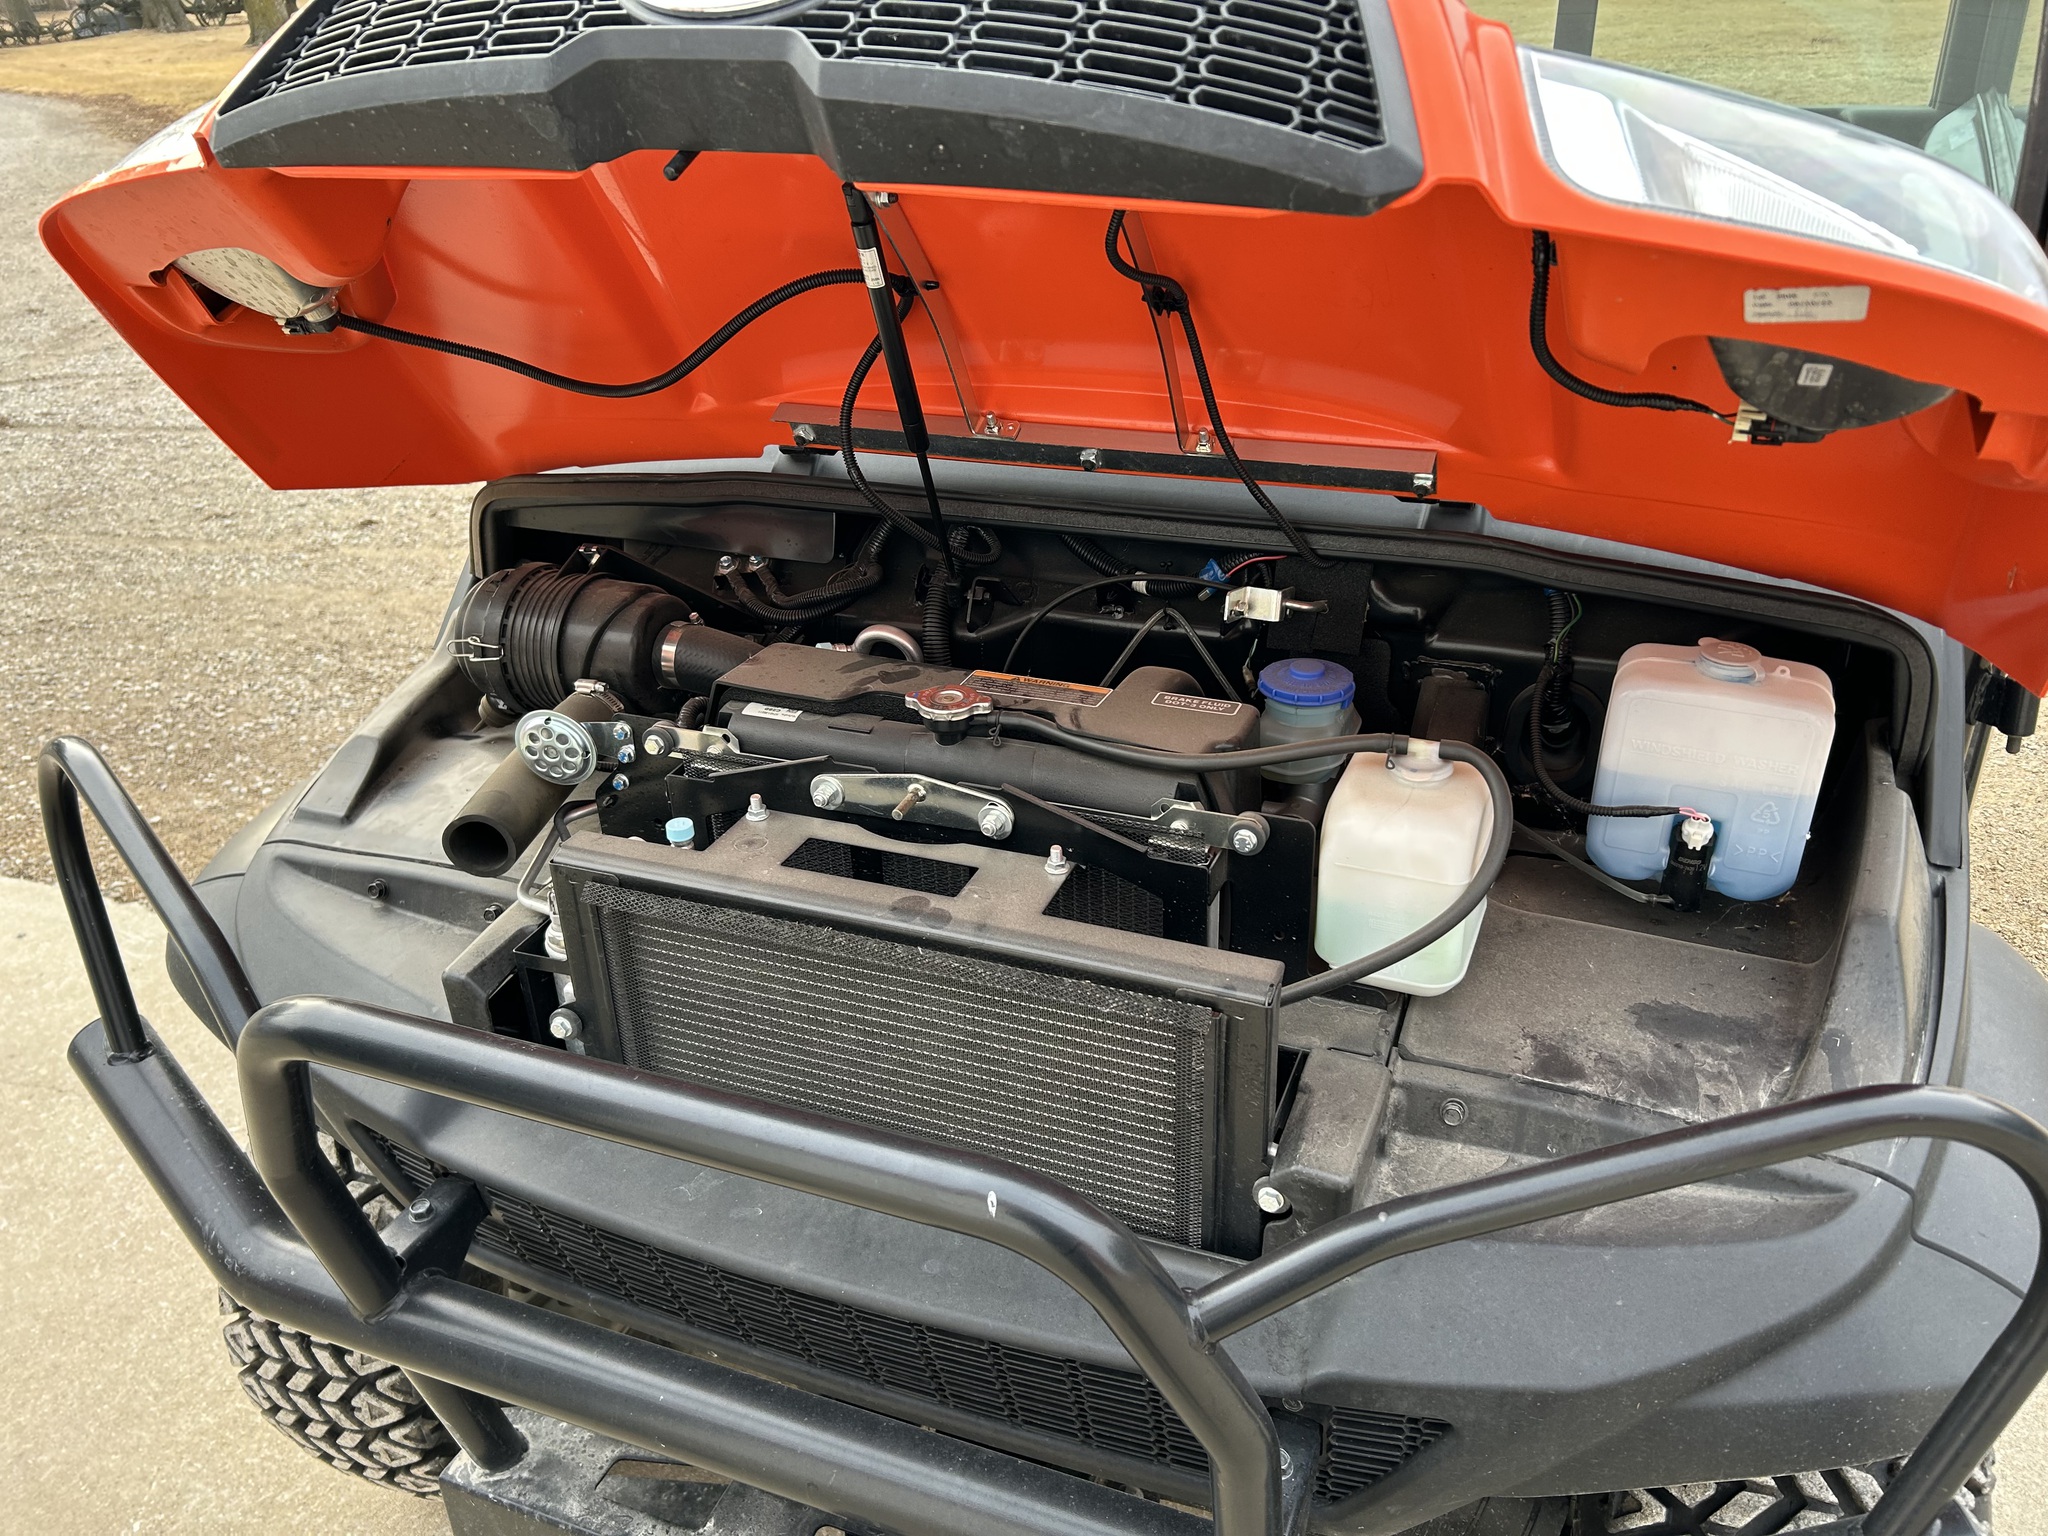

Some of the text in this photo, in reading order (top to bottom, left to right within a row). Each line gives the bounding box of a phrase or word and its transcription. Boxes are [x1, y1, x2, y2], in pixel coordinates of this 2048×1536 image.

[1023, 677, 1071, 688] WARNING
[1163, 695, 1232, 708] BRAKE FLUID
[1164, 700, 1197, 708] DOT-3
[1631, 738, 1800, 775] WINDSHIELD WASHER
